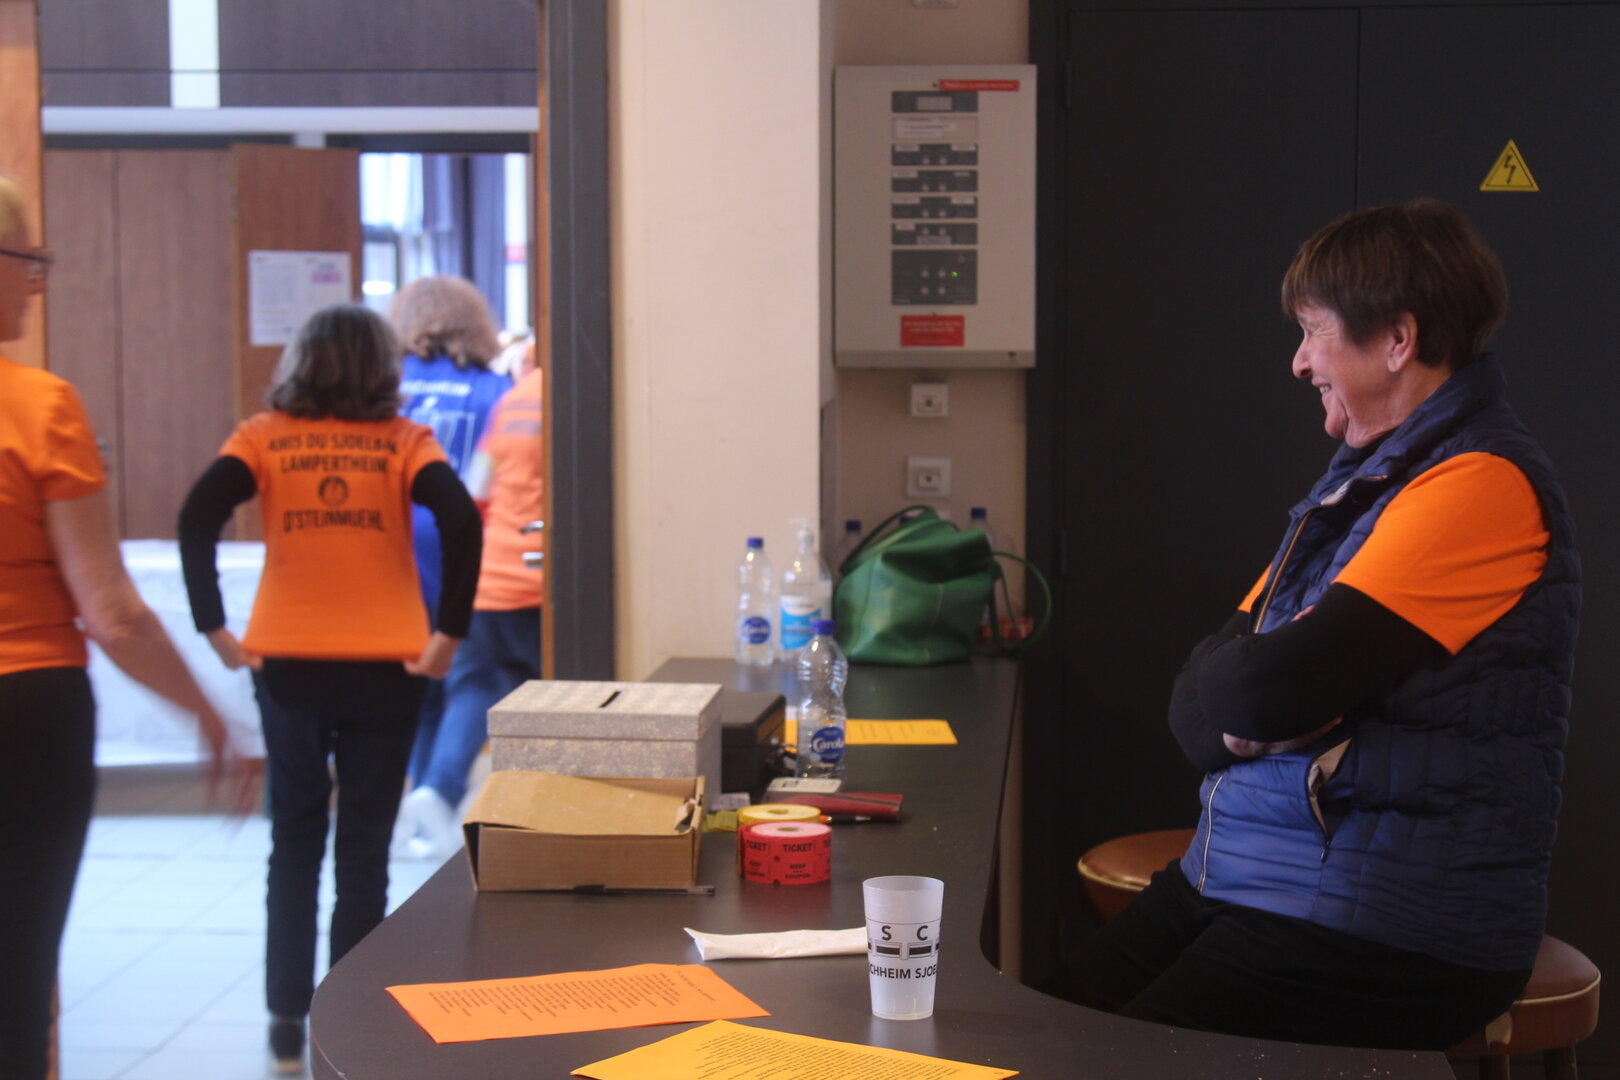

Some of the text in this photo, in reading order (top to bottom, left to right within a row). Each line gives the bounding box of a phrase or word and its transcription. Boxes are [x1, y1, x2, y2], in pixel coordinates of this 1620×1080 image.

[305, 433, 328, 449] DU
[280, 455, 387, 473] LAMPERTHEIM
[782, 842, 813, 853] TICKET
[880, 924, 929, 941] S C
